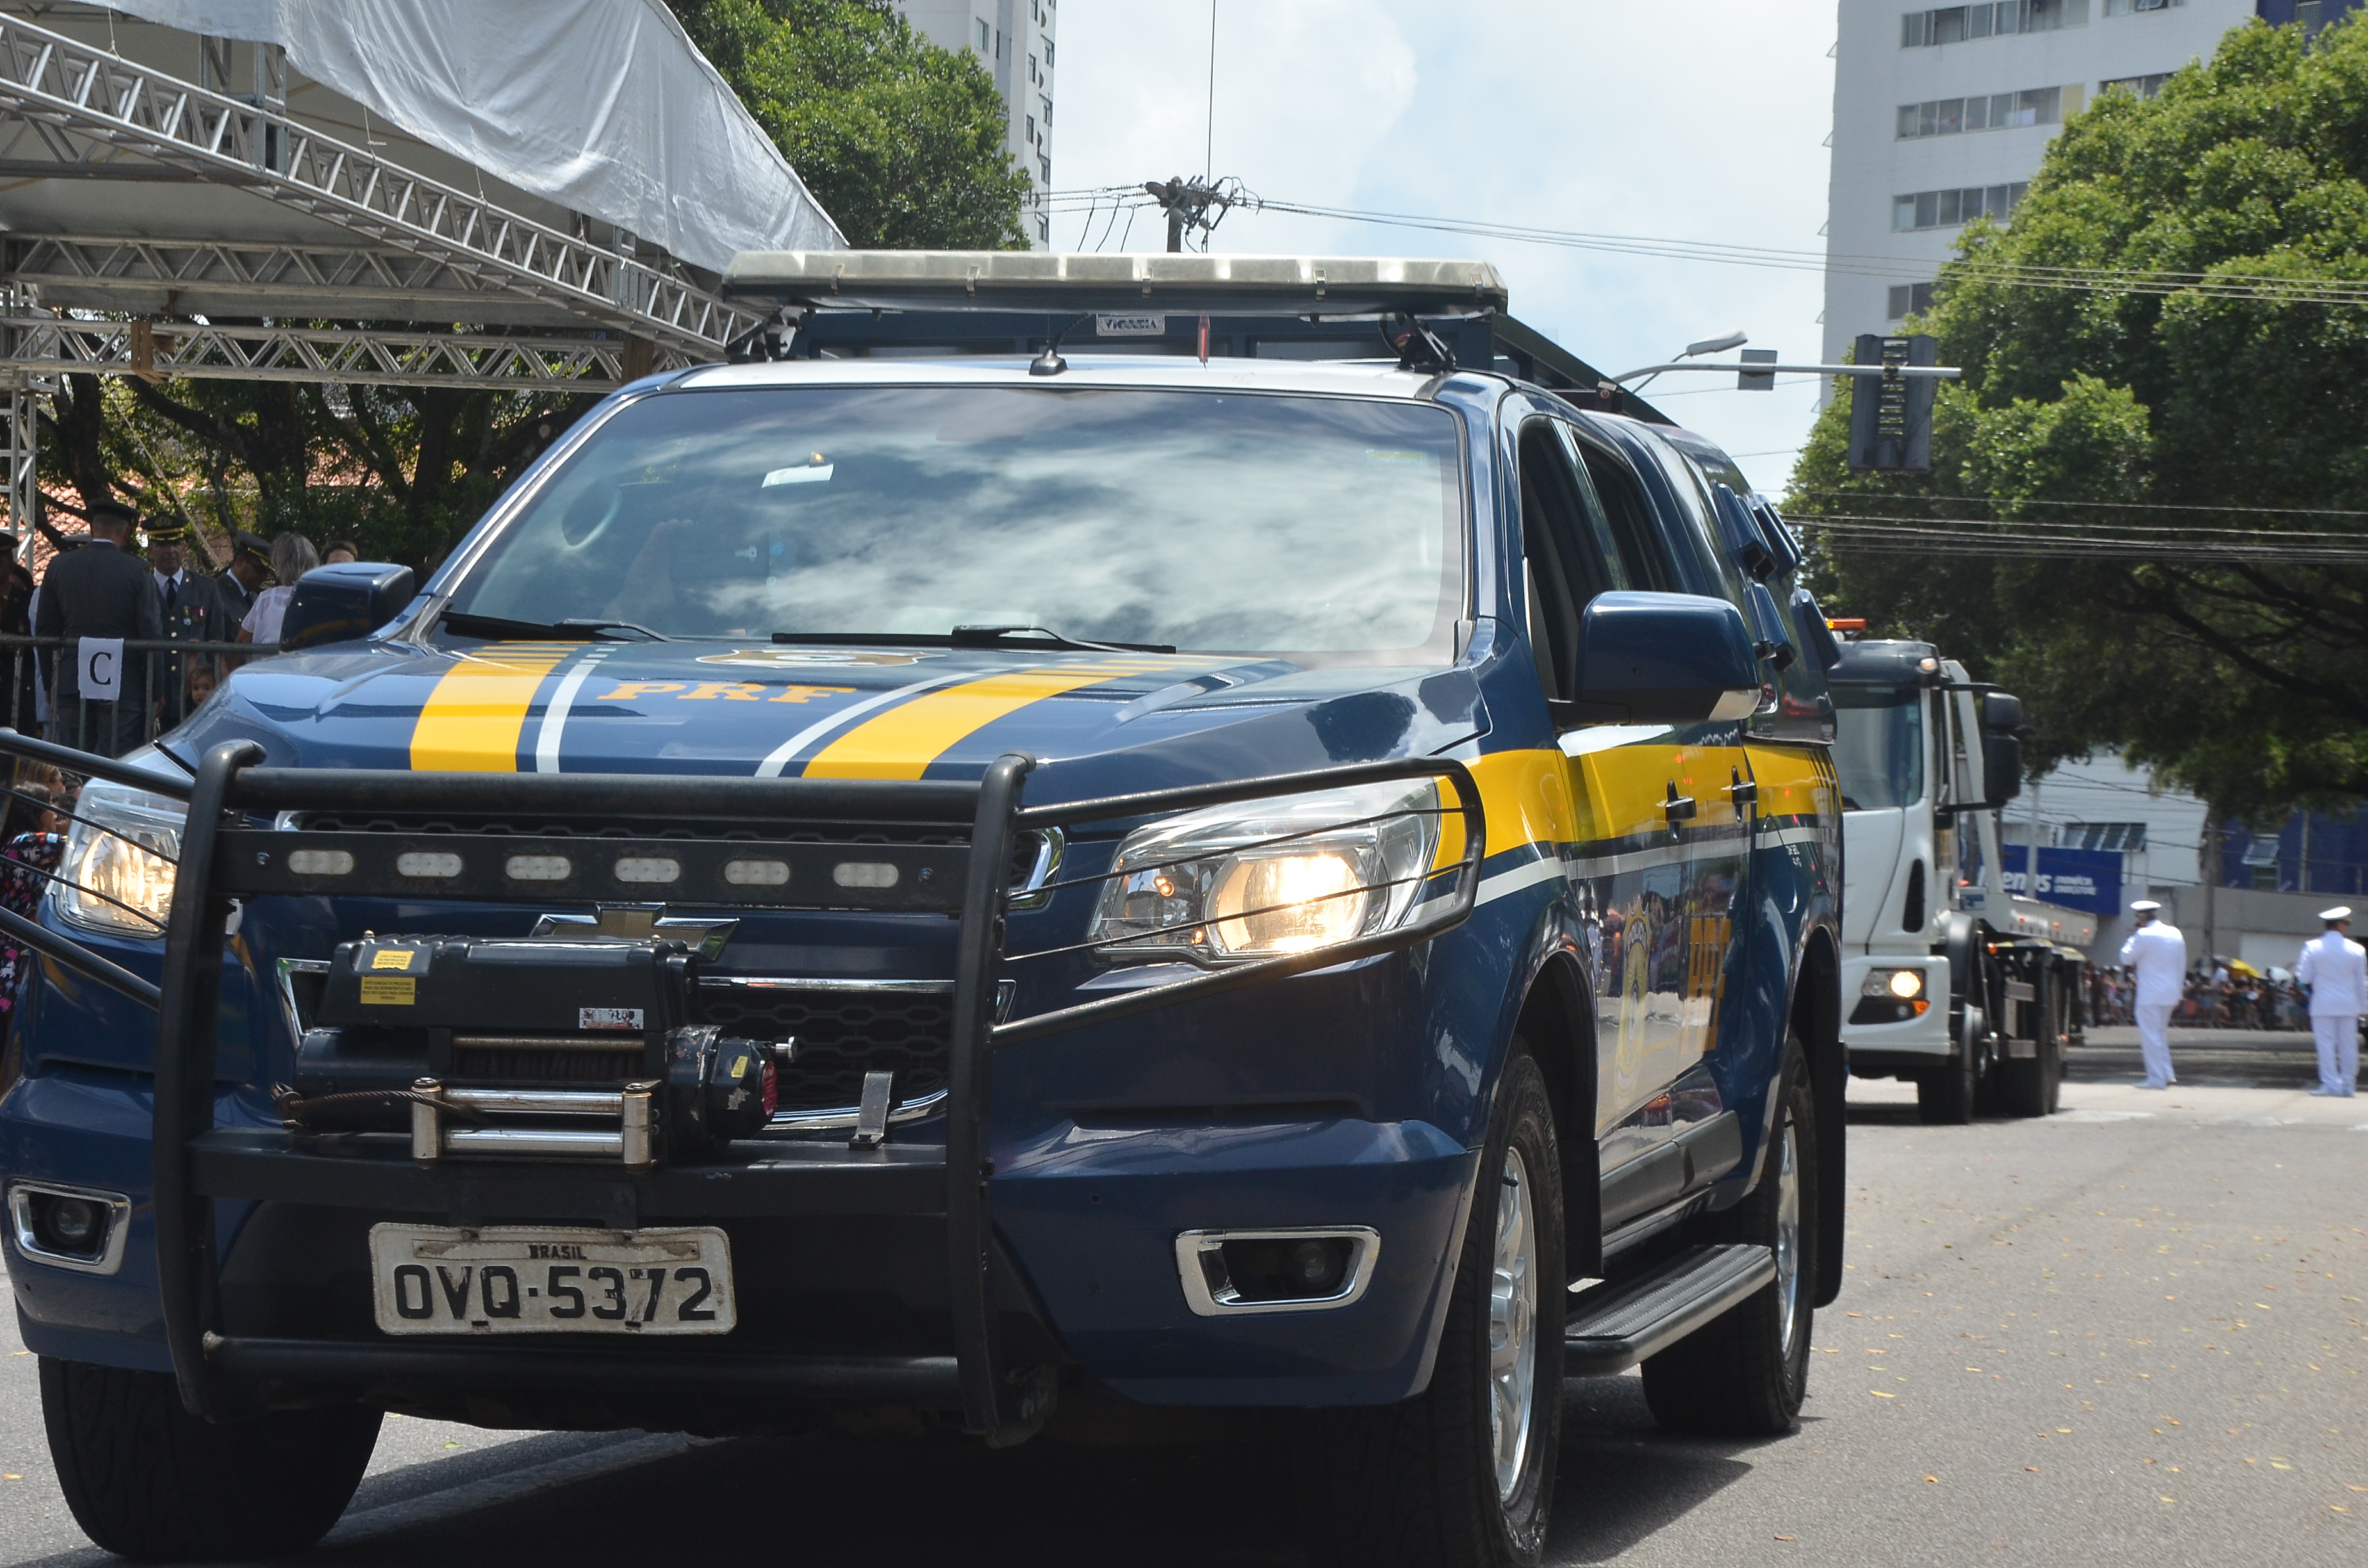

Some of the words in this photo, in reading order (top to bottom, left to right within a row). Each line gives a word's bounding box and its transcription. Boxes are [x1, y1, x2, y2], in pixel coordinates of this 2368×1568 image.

[89, 651, 112, 685] C
[596, 683, 857, 703] PRF
[1680, 918, 1732, 1055] PRF
[529, 1244, 588, 1261] BRASIL
